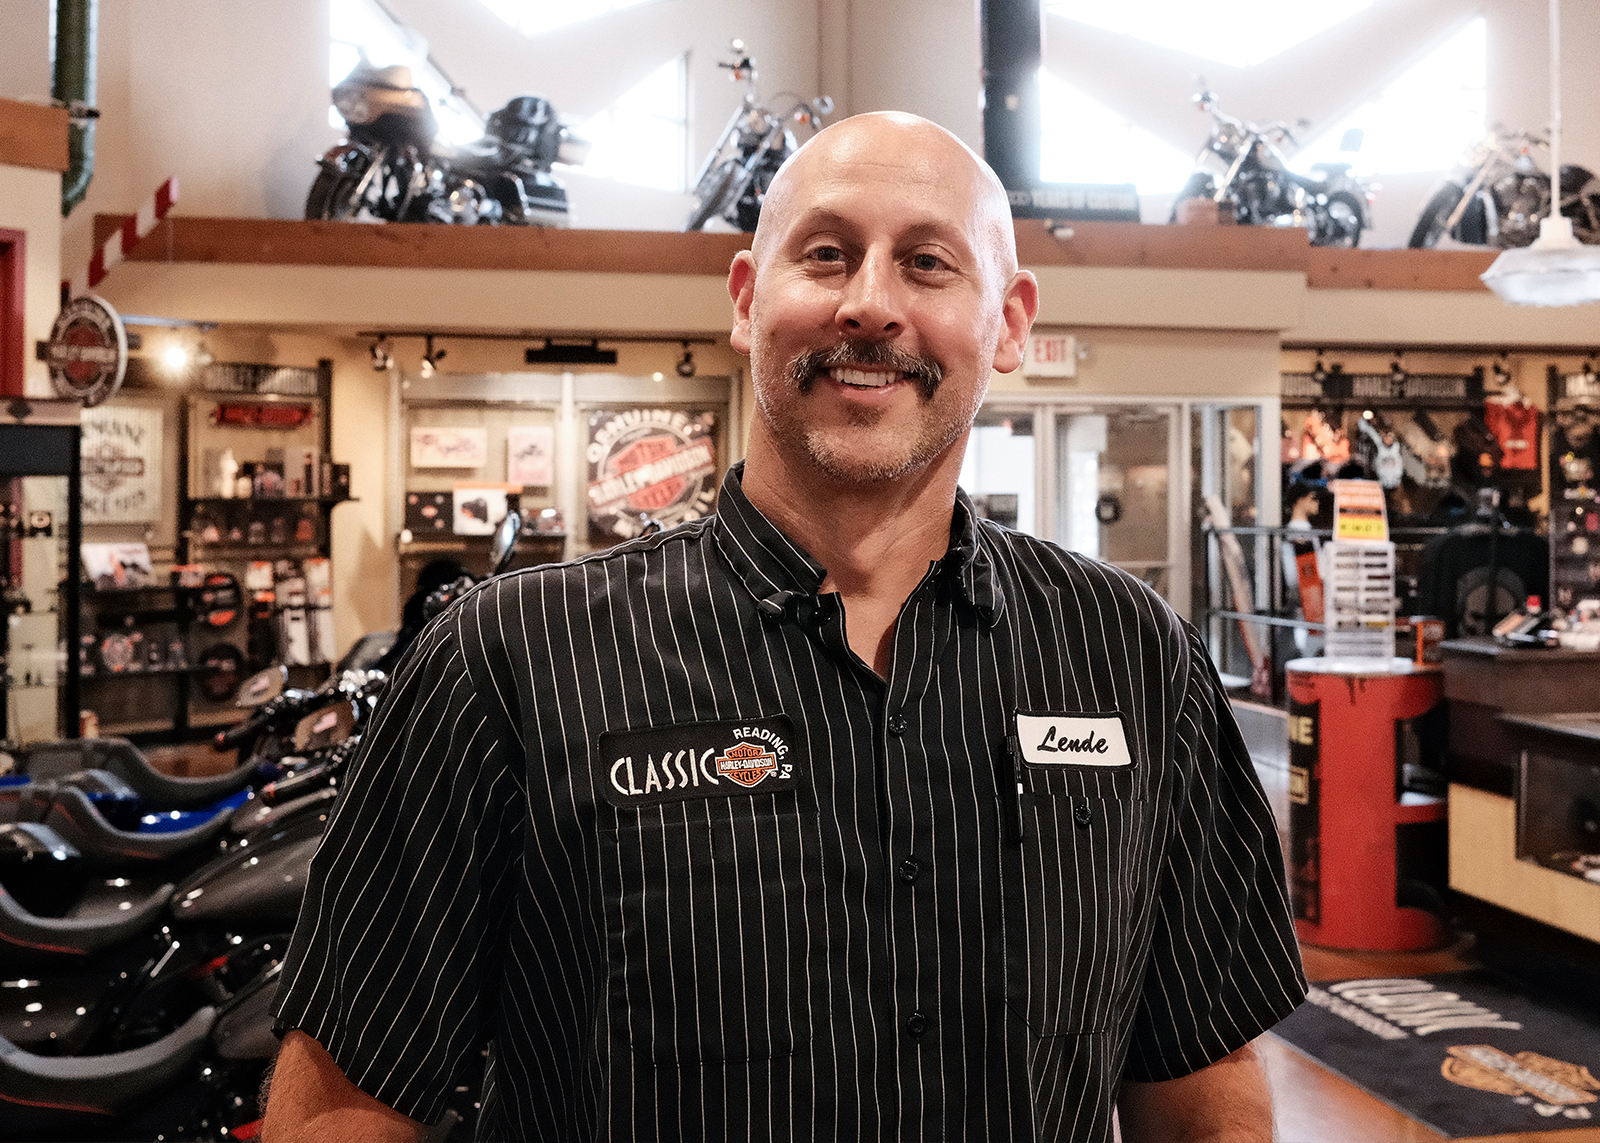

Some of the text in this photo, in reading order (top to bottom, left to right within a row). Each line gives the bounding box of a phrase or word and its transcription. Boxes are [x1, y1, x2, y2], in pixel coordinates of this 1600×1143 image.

[1033, 338, 1067, 363] EXIT
[1036, 725, 1109, 754] Lende
[720, 757, 773, 771] HARLEY-DAVIDSON
[731, 747, 760, 758] MOTOR
[732, 726, 793, 779] READING, PA
[609, 747, 720, 796] CLASSIC
[733, 769, 763, 782] CYCLES
